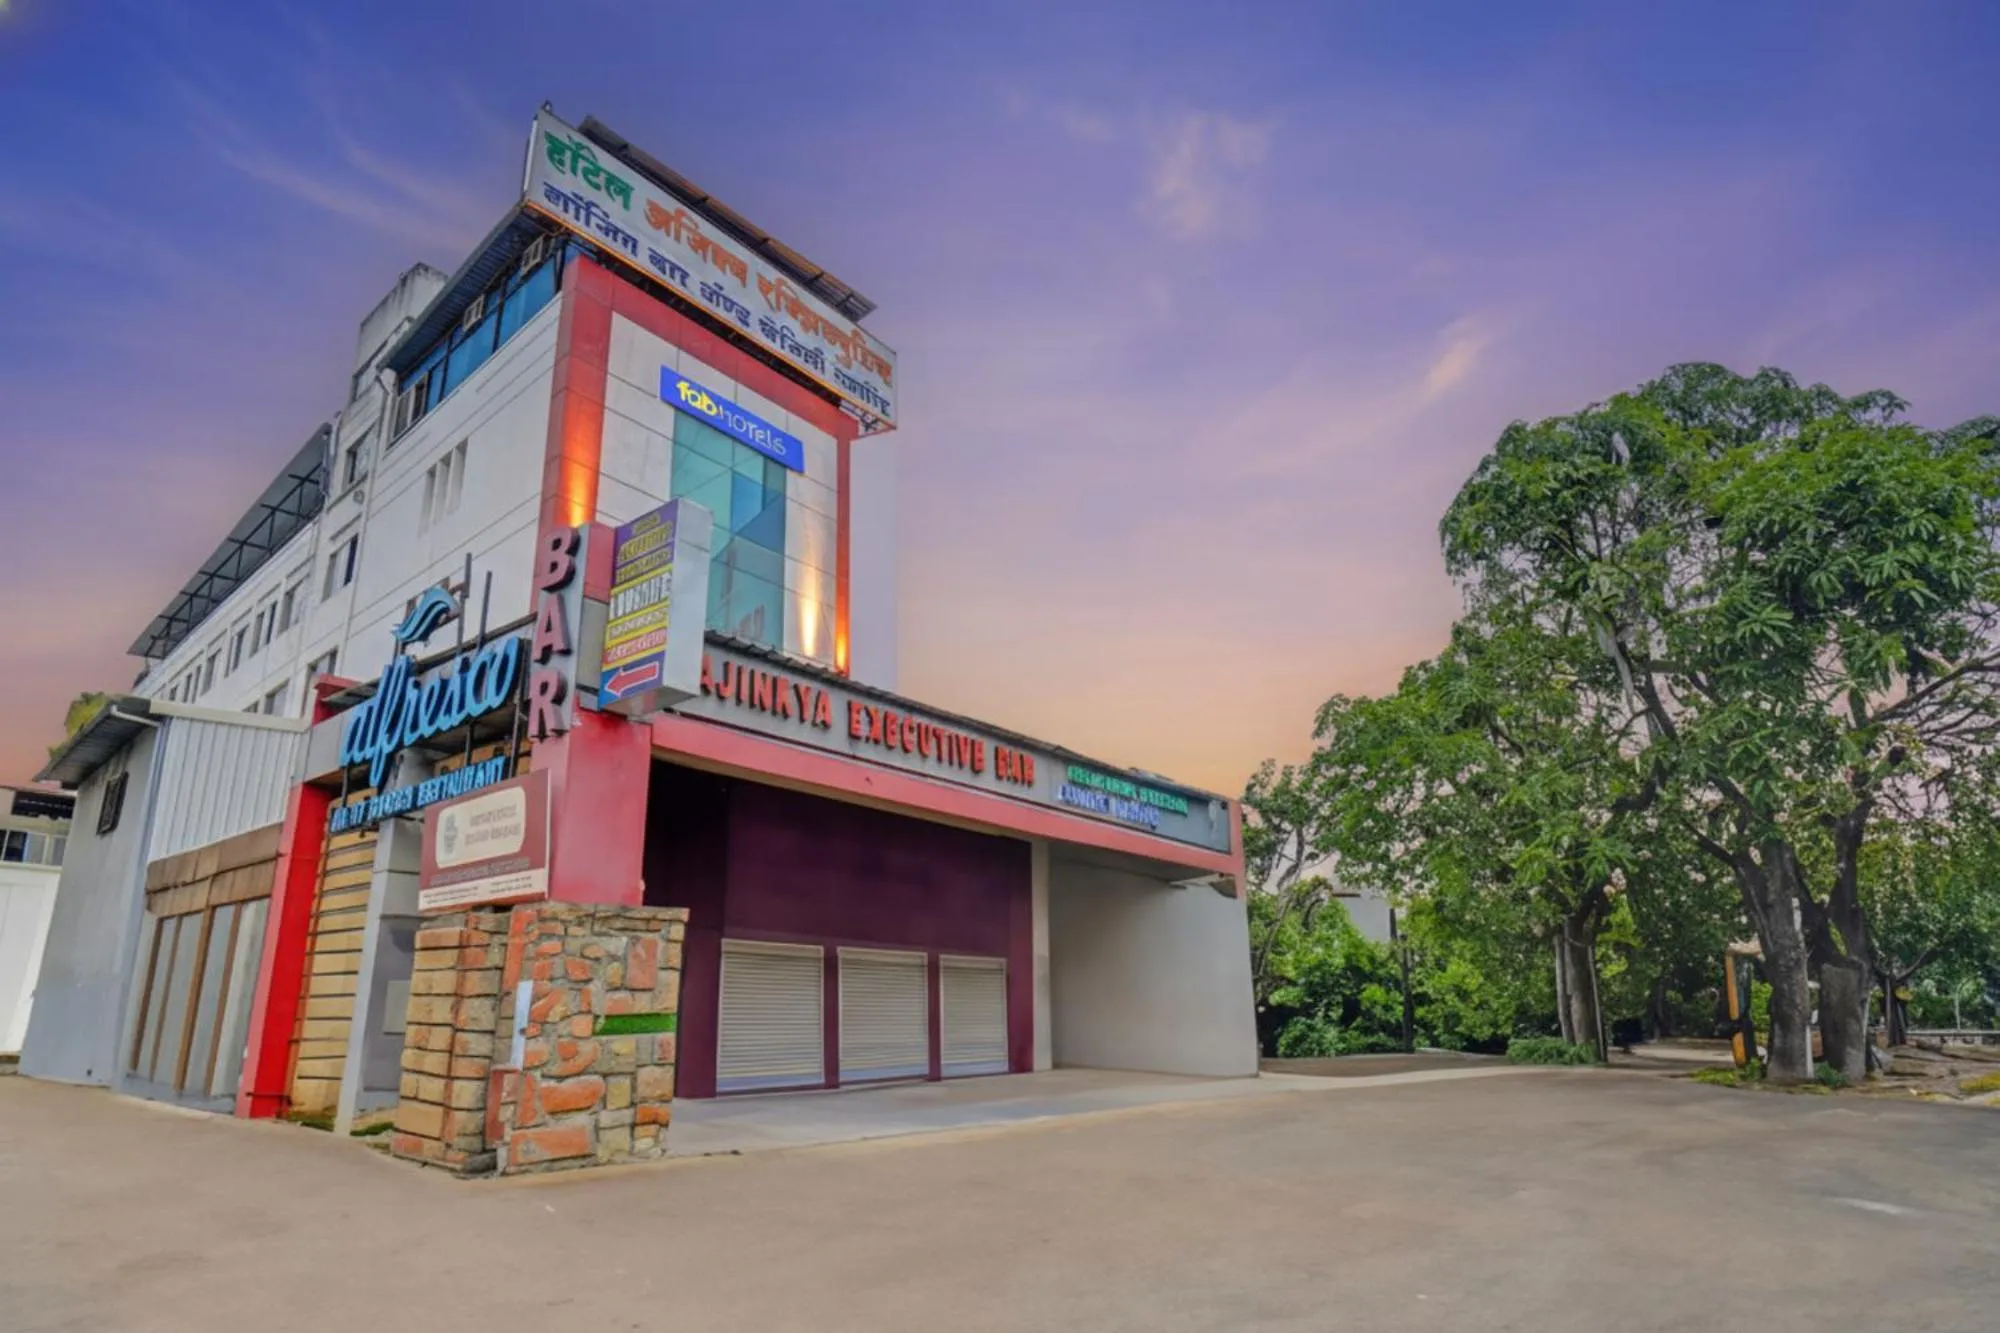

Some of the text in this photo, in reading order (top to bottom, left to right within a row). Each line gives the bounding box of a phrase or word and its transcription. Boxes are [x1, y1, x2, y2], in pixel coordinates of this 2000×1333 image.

[527, 525, 581, 742] BAR
[699, 654, 832, 730] AJINKYA
[847, 698, 985, 774] EXECUTIVE
